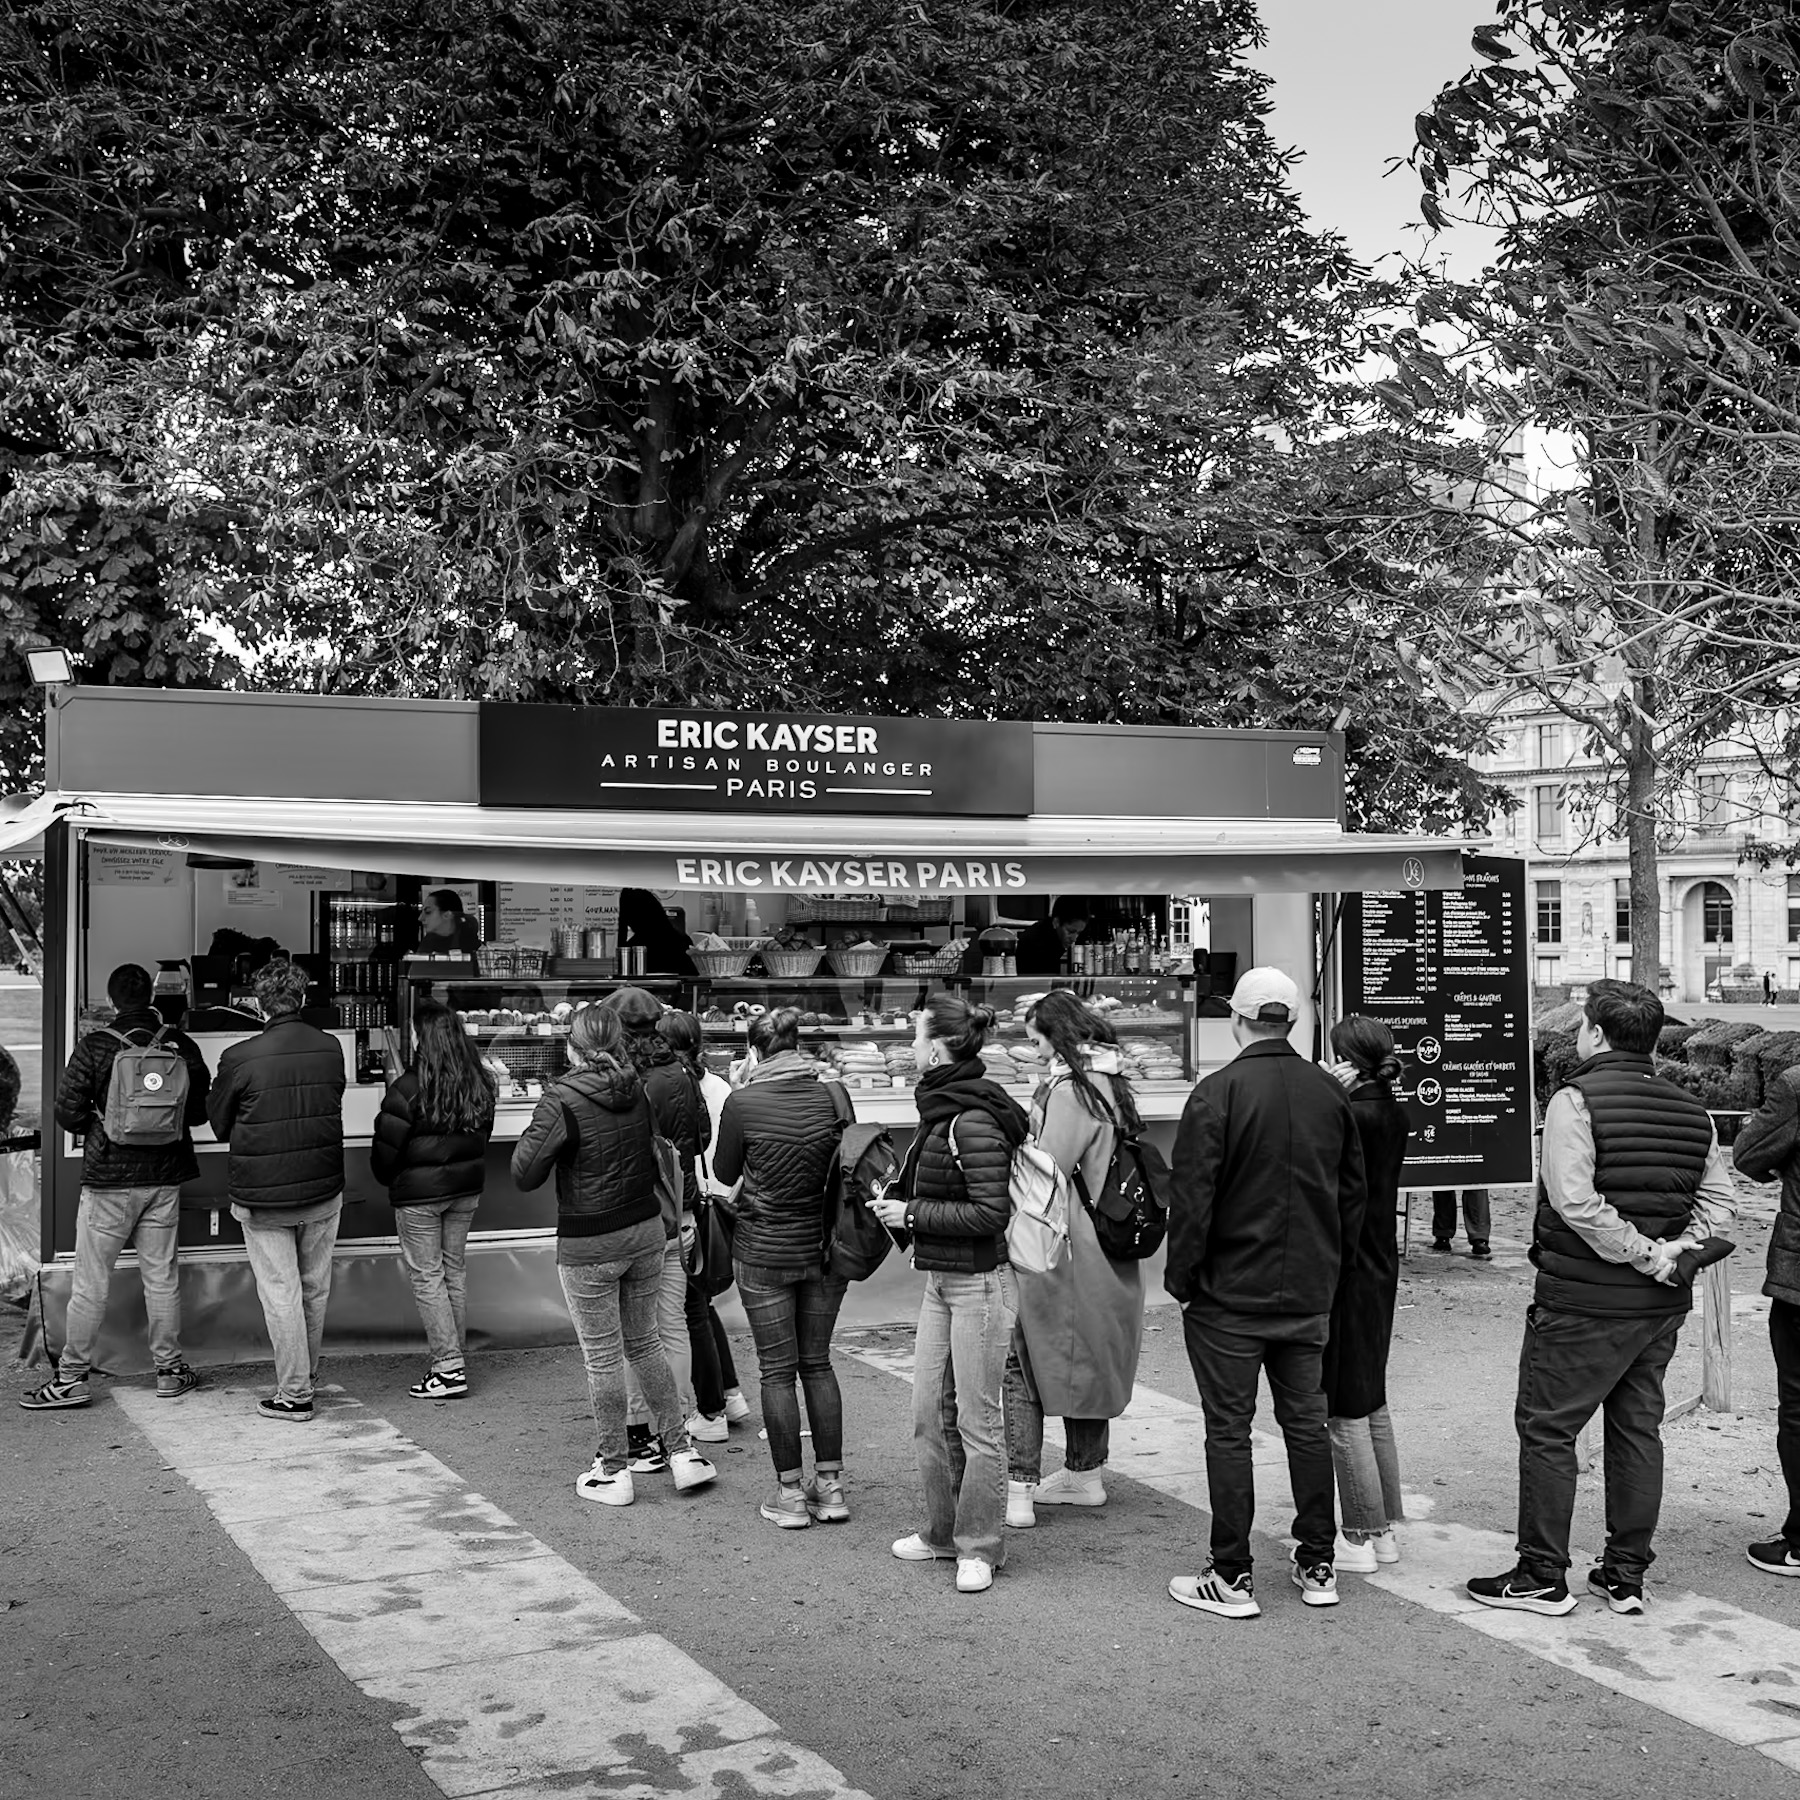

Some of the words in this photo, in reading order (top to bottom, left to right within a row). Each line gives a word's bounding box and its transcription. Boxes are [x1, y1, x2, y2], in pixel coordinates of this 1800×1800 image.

[658, 719, 739, 749] ERIC
[746, 723, 878, 754] KAYSER
[601, 754, 741, 771] ARTISAN
[766, 760, 933, 776] BOULANGER
[726, 778, 817, 799] PARIS
[676, 859, 763, 886] ERIC
[770, 861, 911, 888] KAYSER
[916, 862, 1027, 888] PARIS
